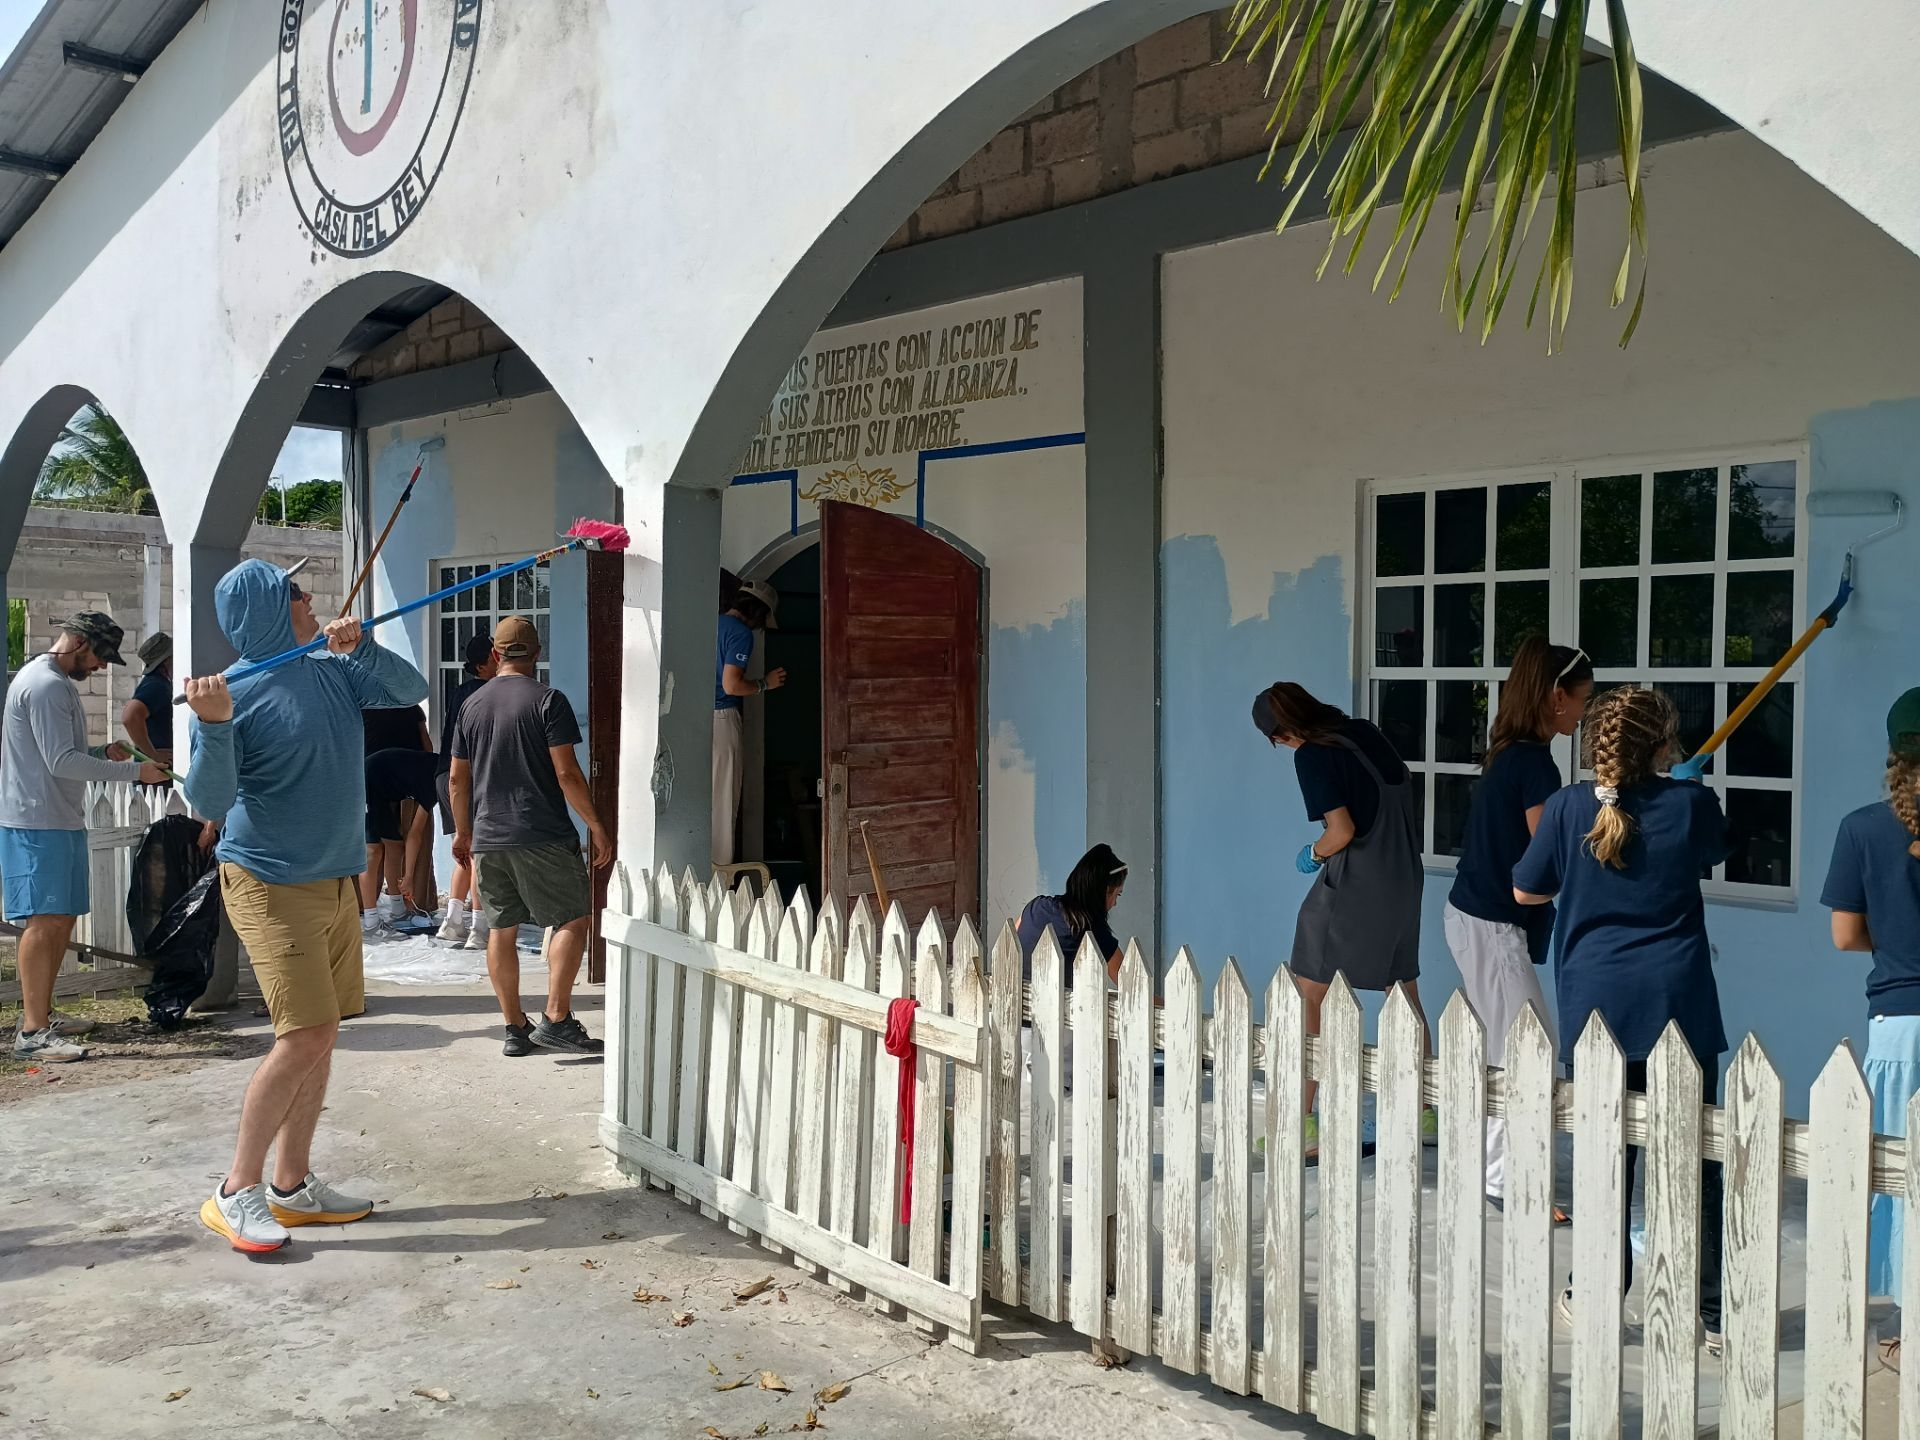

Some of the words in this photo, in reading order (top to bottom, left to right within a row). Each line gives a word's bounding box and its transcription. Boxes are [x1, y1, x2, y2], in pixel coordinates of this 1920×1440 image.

[281, 66, 302, 160] FULL
[314, 197, 348, 249] CASA
[352, 207, 387, 249] DEL
[391, 156, 426, 229] REY
[812, 341, 890, 390] PUERTAS
[895, 330, 932, 373] CON
[937, 316, 1007, 366] ACCION
[1010, 309, 1042, 351] DE
[778, 393, 810, 431] SUS
[811, 383, 874, 426] ATRIOS
[879, 375, 915, 415] CON
[783, 424, 860, 469] BENDECID
[865, 420, 890, 457] SU
[892, 408, 968, 453] NOMBRE.
